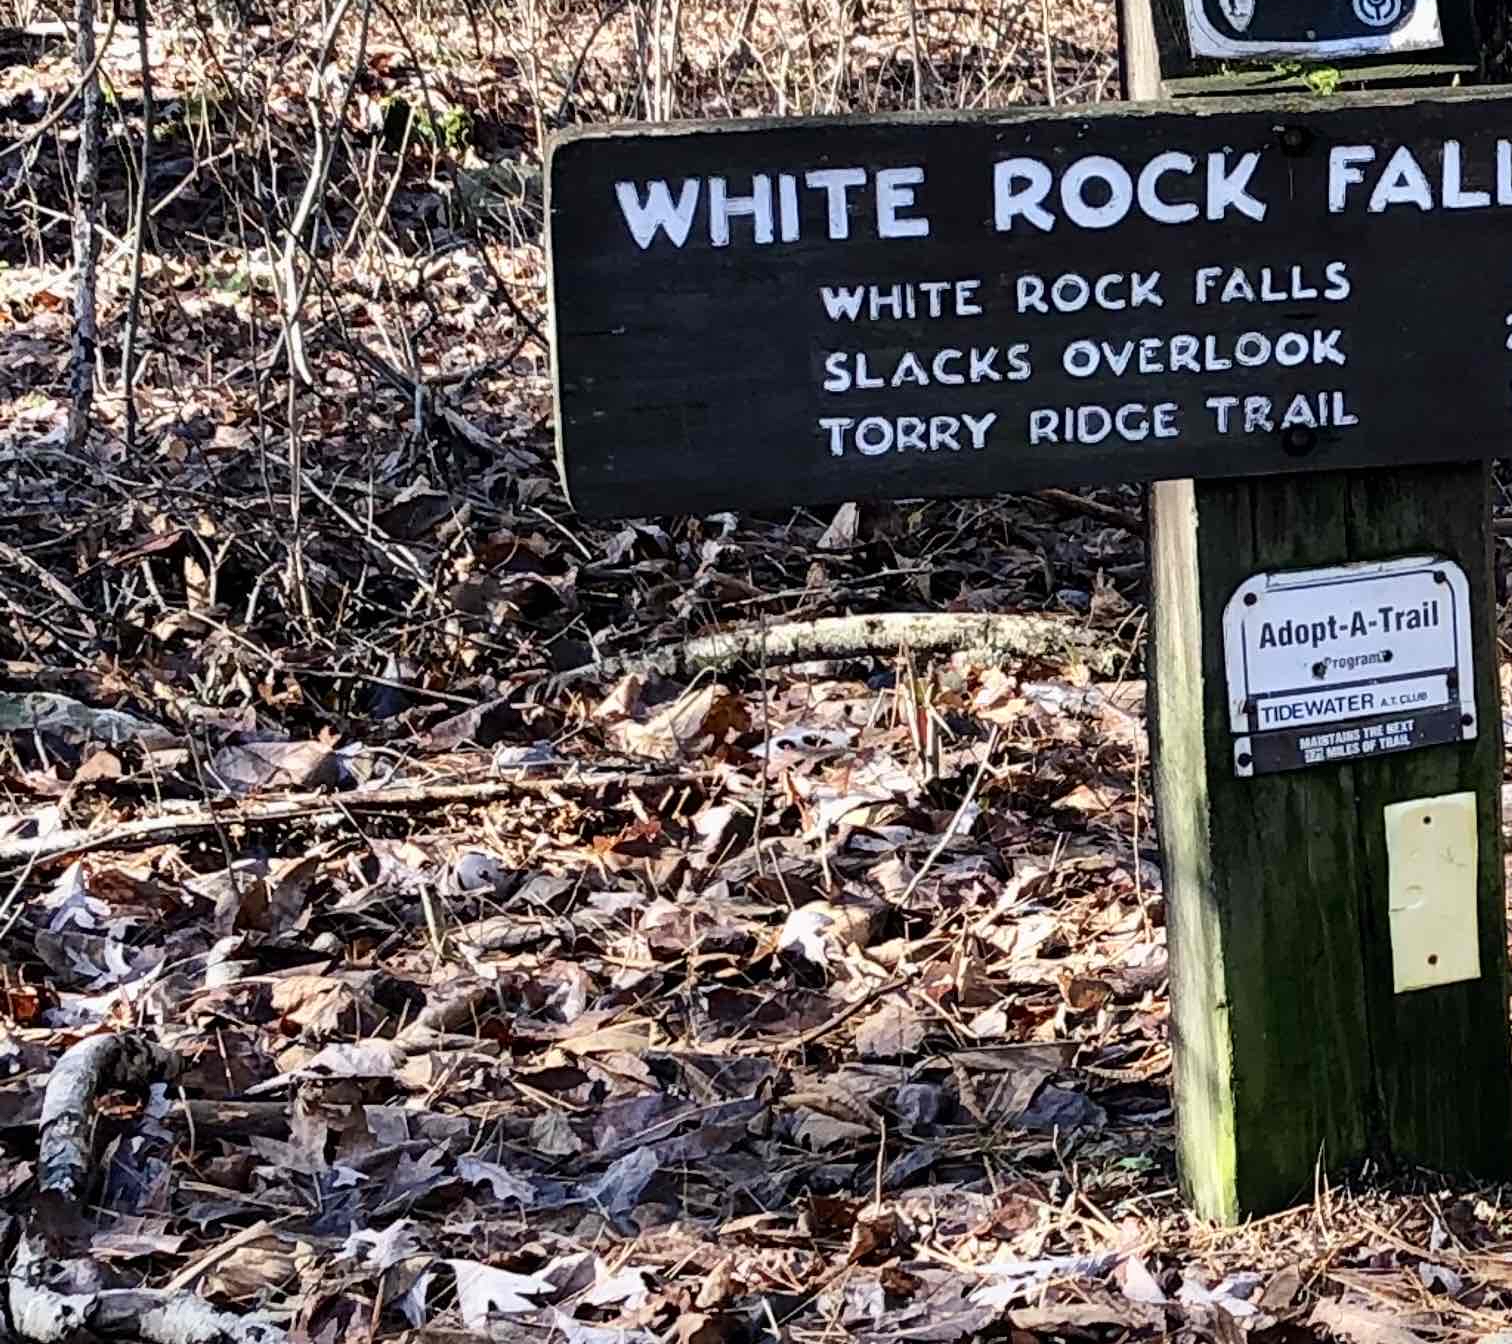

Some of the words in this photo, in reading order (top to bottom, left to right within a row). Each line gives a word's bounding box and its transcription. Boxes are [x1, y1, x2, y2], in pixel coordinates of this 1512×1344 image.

[615, 167, 930, 250] WHITE
[993, 151, 1267, 233] ROCK
[820, 280, 984, 322] WHITE
[1017, 270, 1164, 313] ROCK
[1195, 262, 1351, 305] FALLS
[822, 343, 1032, 393] SLACKS
[1063, 329, 1346, 378] OVERLOOK
[819, 411, 998, 456] TORRY
[1030, 402, 1180, 445] RIDGE
[1206, 392, 1358, 434] TRAIL
[1259, 600, 1439, 649] Adopt-A-Trail
[1261, 692, 1374, 724] TIDEWATER
[1400, 691, 1428, 705] CLUB
[1362, 724, 1384, 739] THE
[1362, 739, 1377, 753] OF
[1379, 733, 1410, 749] TRAIL
